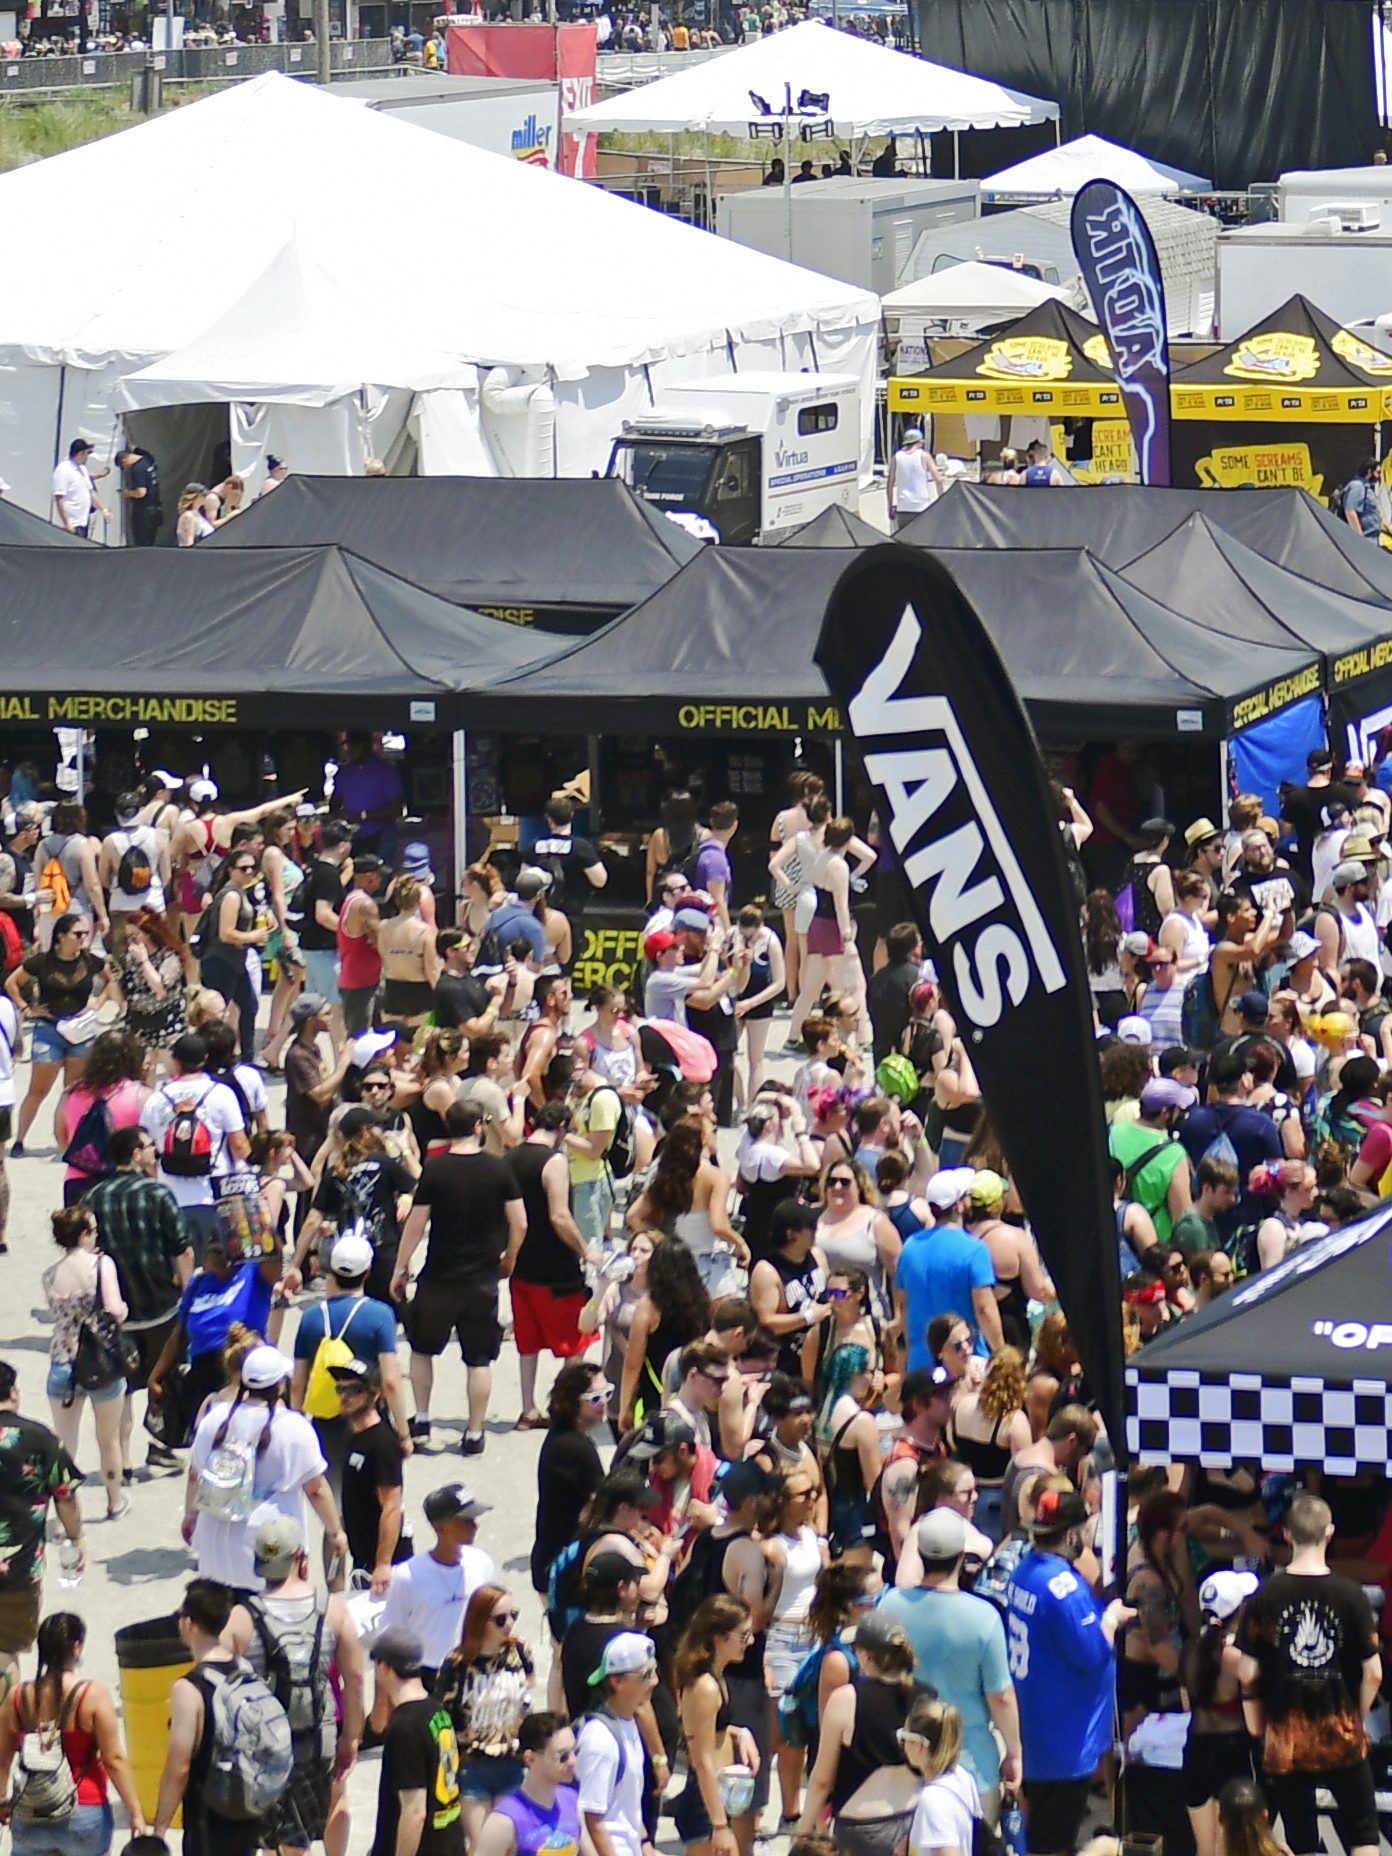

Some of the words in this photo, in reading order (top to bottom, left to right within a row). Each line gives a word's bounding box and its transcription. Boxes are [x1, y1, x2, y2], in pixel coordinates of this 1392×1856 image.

[511, 114, 553, 150] miller
[775, 448, 808, 469] Virtua
[1093, 445, 1126, 458] CAN'T
[1221, 455, 1249, 471] SOME
[1255, 452, 1304, 469] SCREAMS
[1095, 459, 1128, 473] HEARD
[1257, 469, 1289, 484] CAN'T
[1292, 468, 1306, 482] BE
[1334, 653, 1371, 684] OFFICIAL
[1233, 697, 1270, 728] OFFICIAL
[1268, 664, 1321, 712] MERCHANDISE
[48, 697, 238, 723] MERCHANDISE
[679, 705, 797, 731] OFFICIAL
[849, 603, 1067, 1028] VANS
